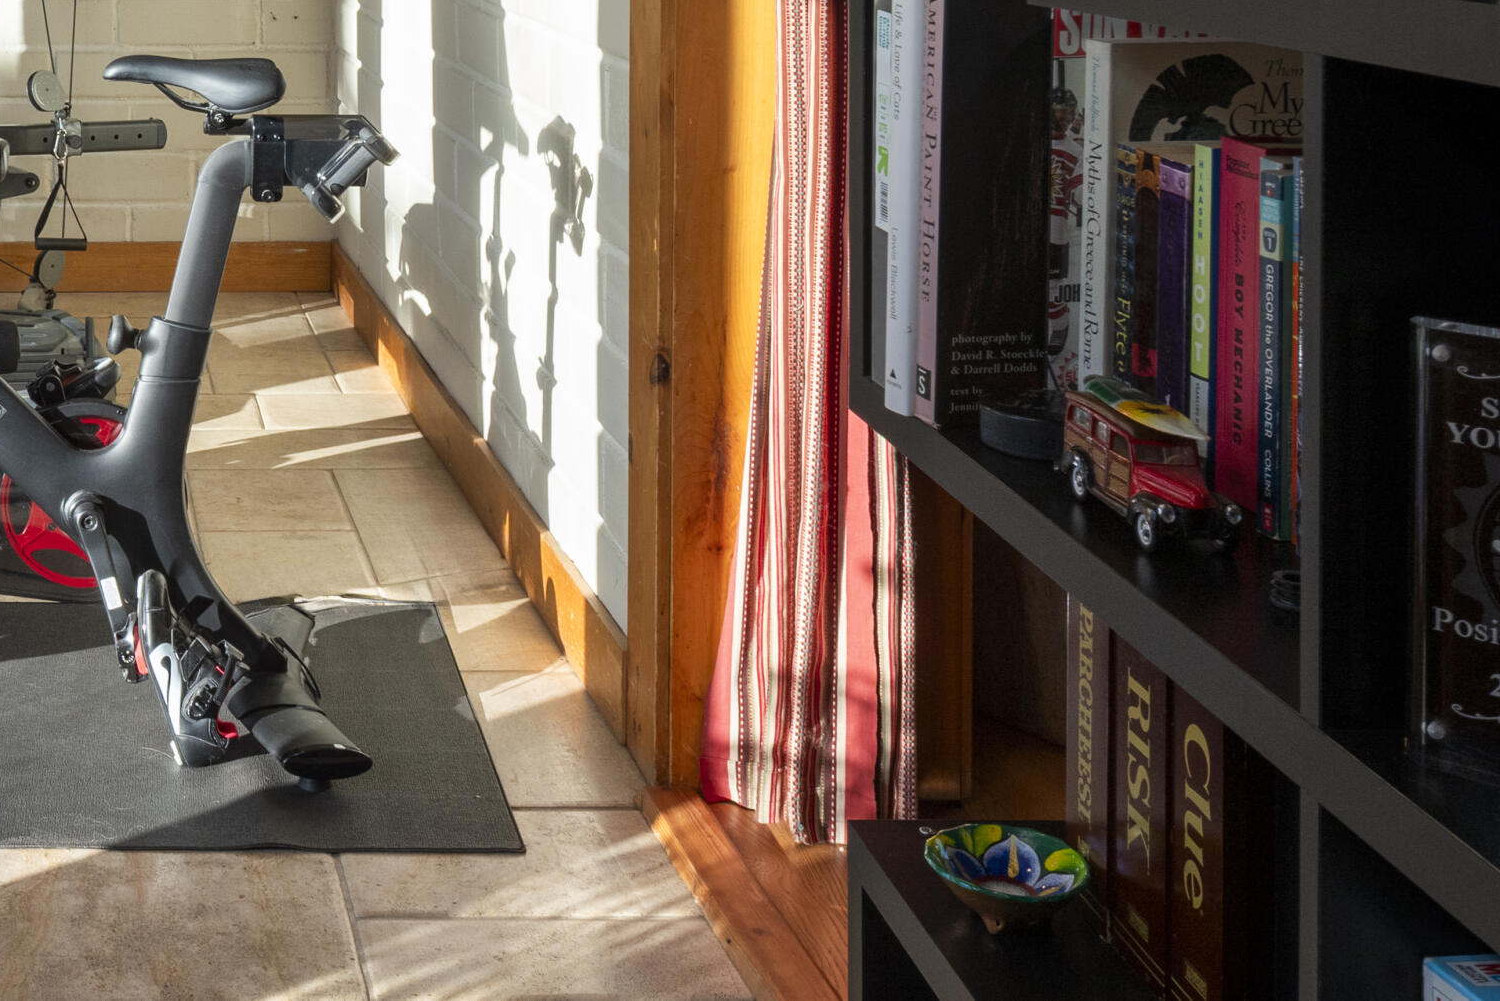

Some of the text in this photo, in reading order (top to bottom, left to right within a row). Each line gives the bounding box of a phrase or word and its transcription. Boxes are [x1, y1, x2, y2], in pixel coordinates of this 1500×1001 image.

[893, 3, 903, 26] Life
[893, 44, 903, 73] Love
[893, 91, 902, 120] Cats
[923, 132, 938, 208] PAINT
[890, 227, 900, 320] Lewis Blackwell
[921, 218, 937, 303] HORSE
[1083, 139, 1104, 370] Myths of Greece and Rome
[1114, 296, 1132, 357] Flyte
[1193, 253, 1206, 363] HOOT
[1233, 272, 1246, 320] BOY
[950, 331, 1033, 348] photography by
[950, 361, 1039, 376] & Darrell Dodds
[951, 349, 982, 361] David
[986, 349, 997, 360] R.
[1263, 263, 1274, 439] GREGOR the OVERLANDER
[1232, 326, 1245, 446] MECHANIC
[1444, 420, 1500, 450] YO
[1263, 448, 1272, 498] COLLINS
[1076, 602, 1094, 832] PARCHEESI
[1126, 666, 1152, 875] RISK
[1182, 722, 1213, 917] Clue
